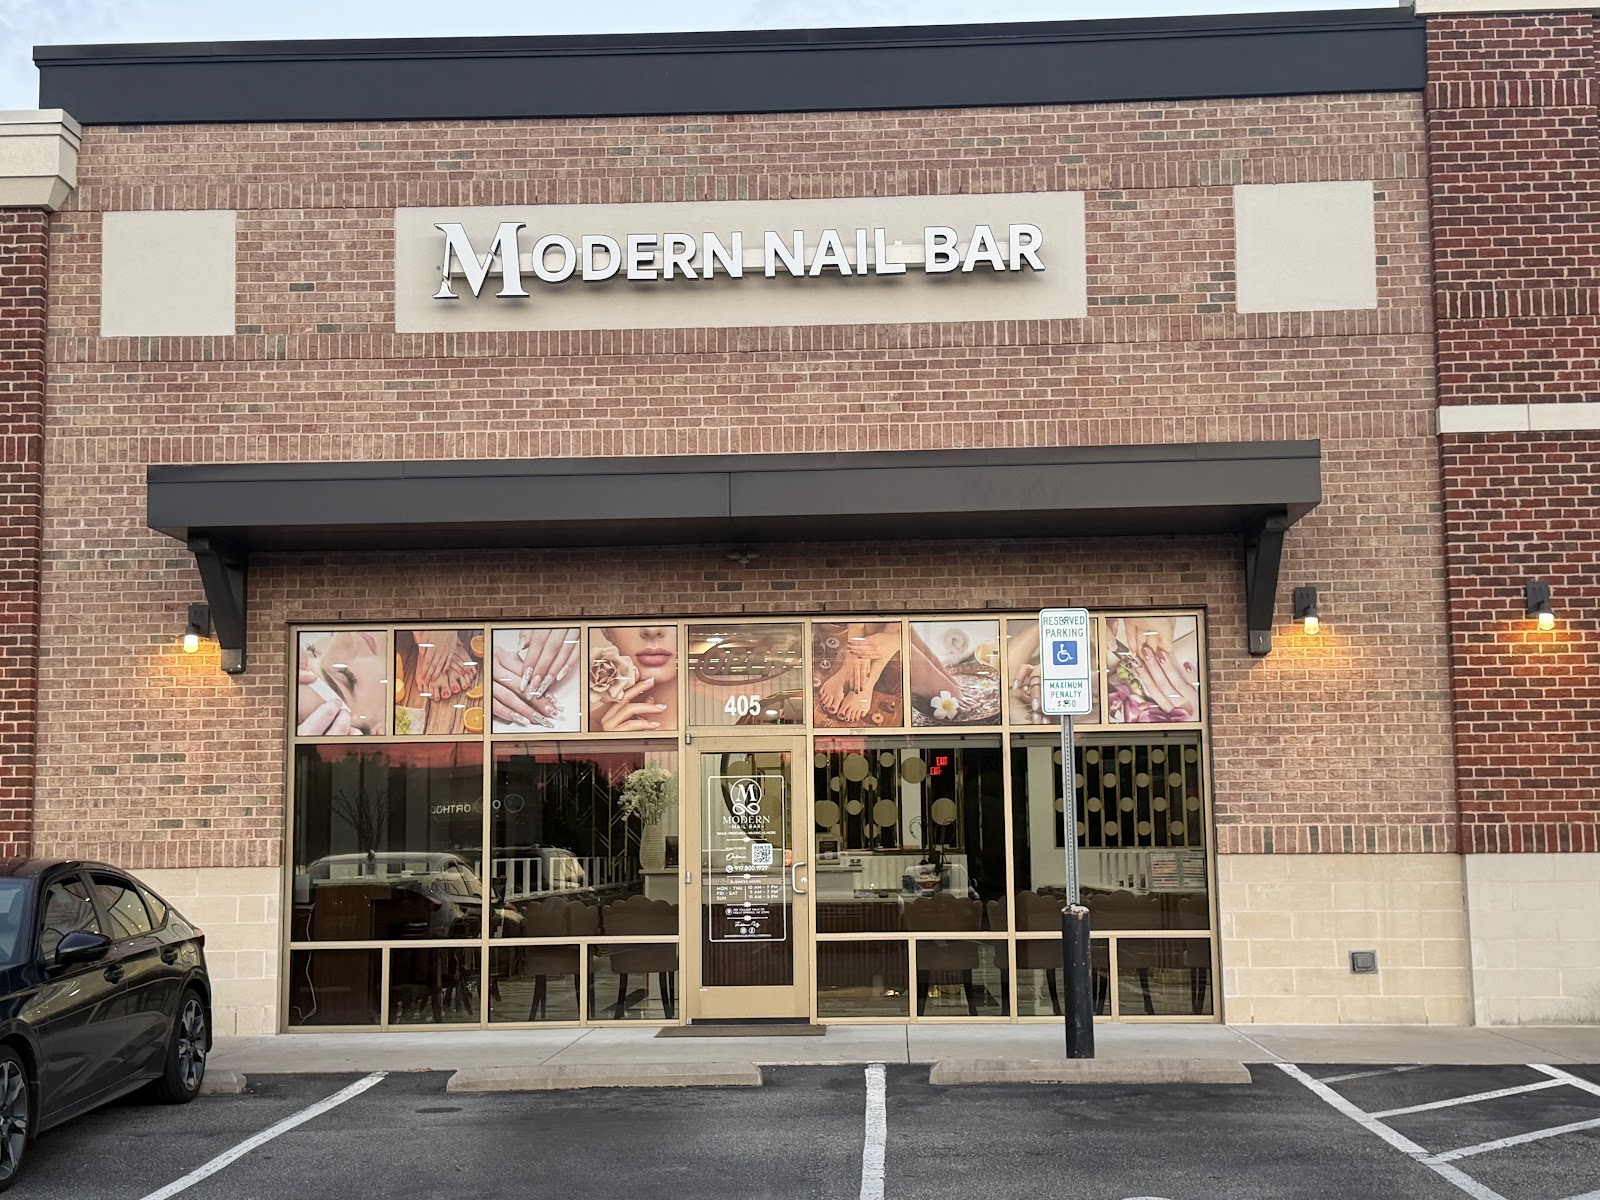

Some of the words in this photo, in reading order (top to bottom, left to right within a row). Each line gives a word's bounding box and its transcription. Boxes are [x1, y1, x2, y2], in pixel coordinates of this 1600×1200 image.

[432, 222, 743, 298] MODERN
[763, 227, 907, 278] NAIL
[924, 223, 1046, 274] BAR
[1043, 616, 1085, 625] RESERVED
[1046, 628, 1084, 638] PARKING
[724, 695, 761, 716] 405
[722, 815, 770, 824] MODERN
